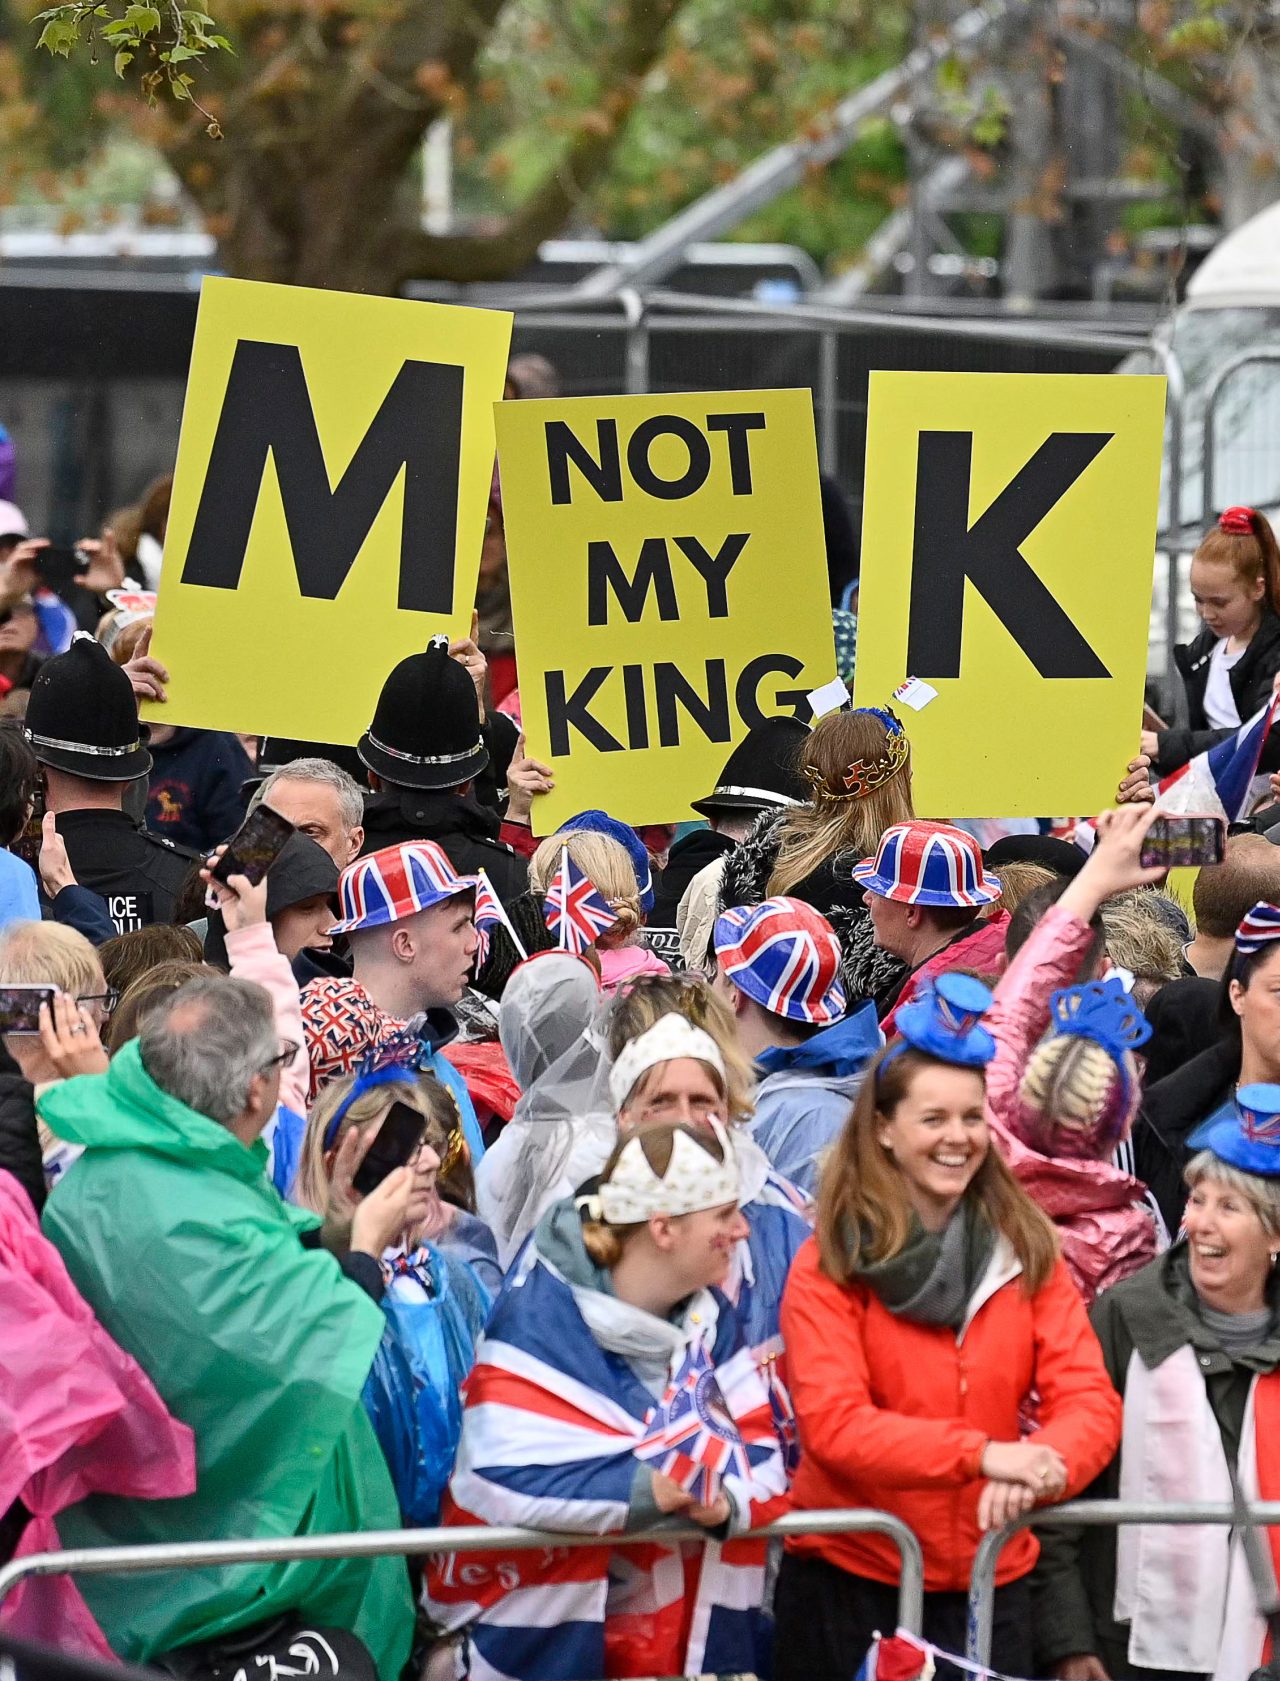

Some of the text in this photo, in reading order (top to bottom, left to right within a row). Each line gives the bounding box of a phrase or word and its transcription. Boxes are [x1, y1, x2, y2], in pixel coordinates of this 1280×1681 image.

[181, 339, 464, 615] M
[545, 413, 765, 504] NOT
[588, 533, 751, 626] MY
[906, 431, 1115, 678] K
[545, 653, 814, 757] KING
[108, 896, 138, 918] ICE
